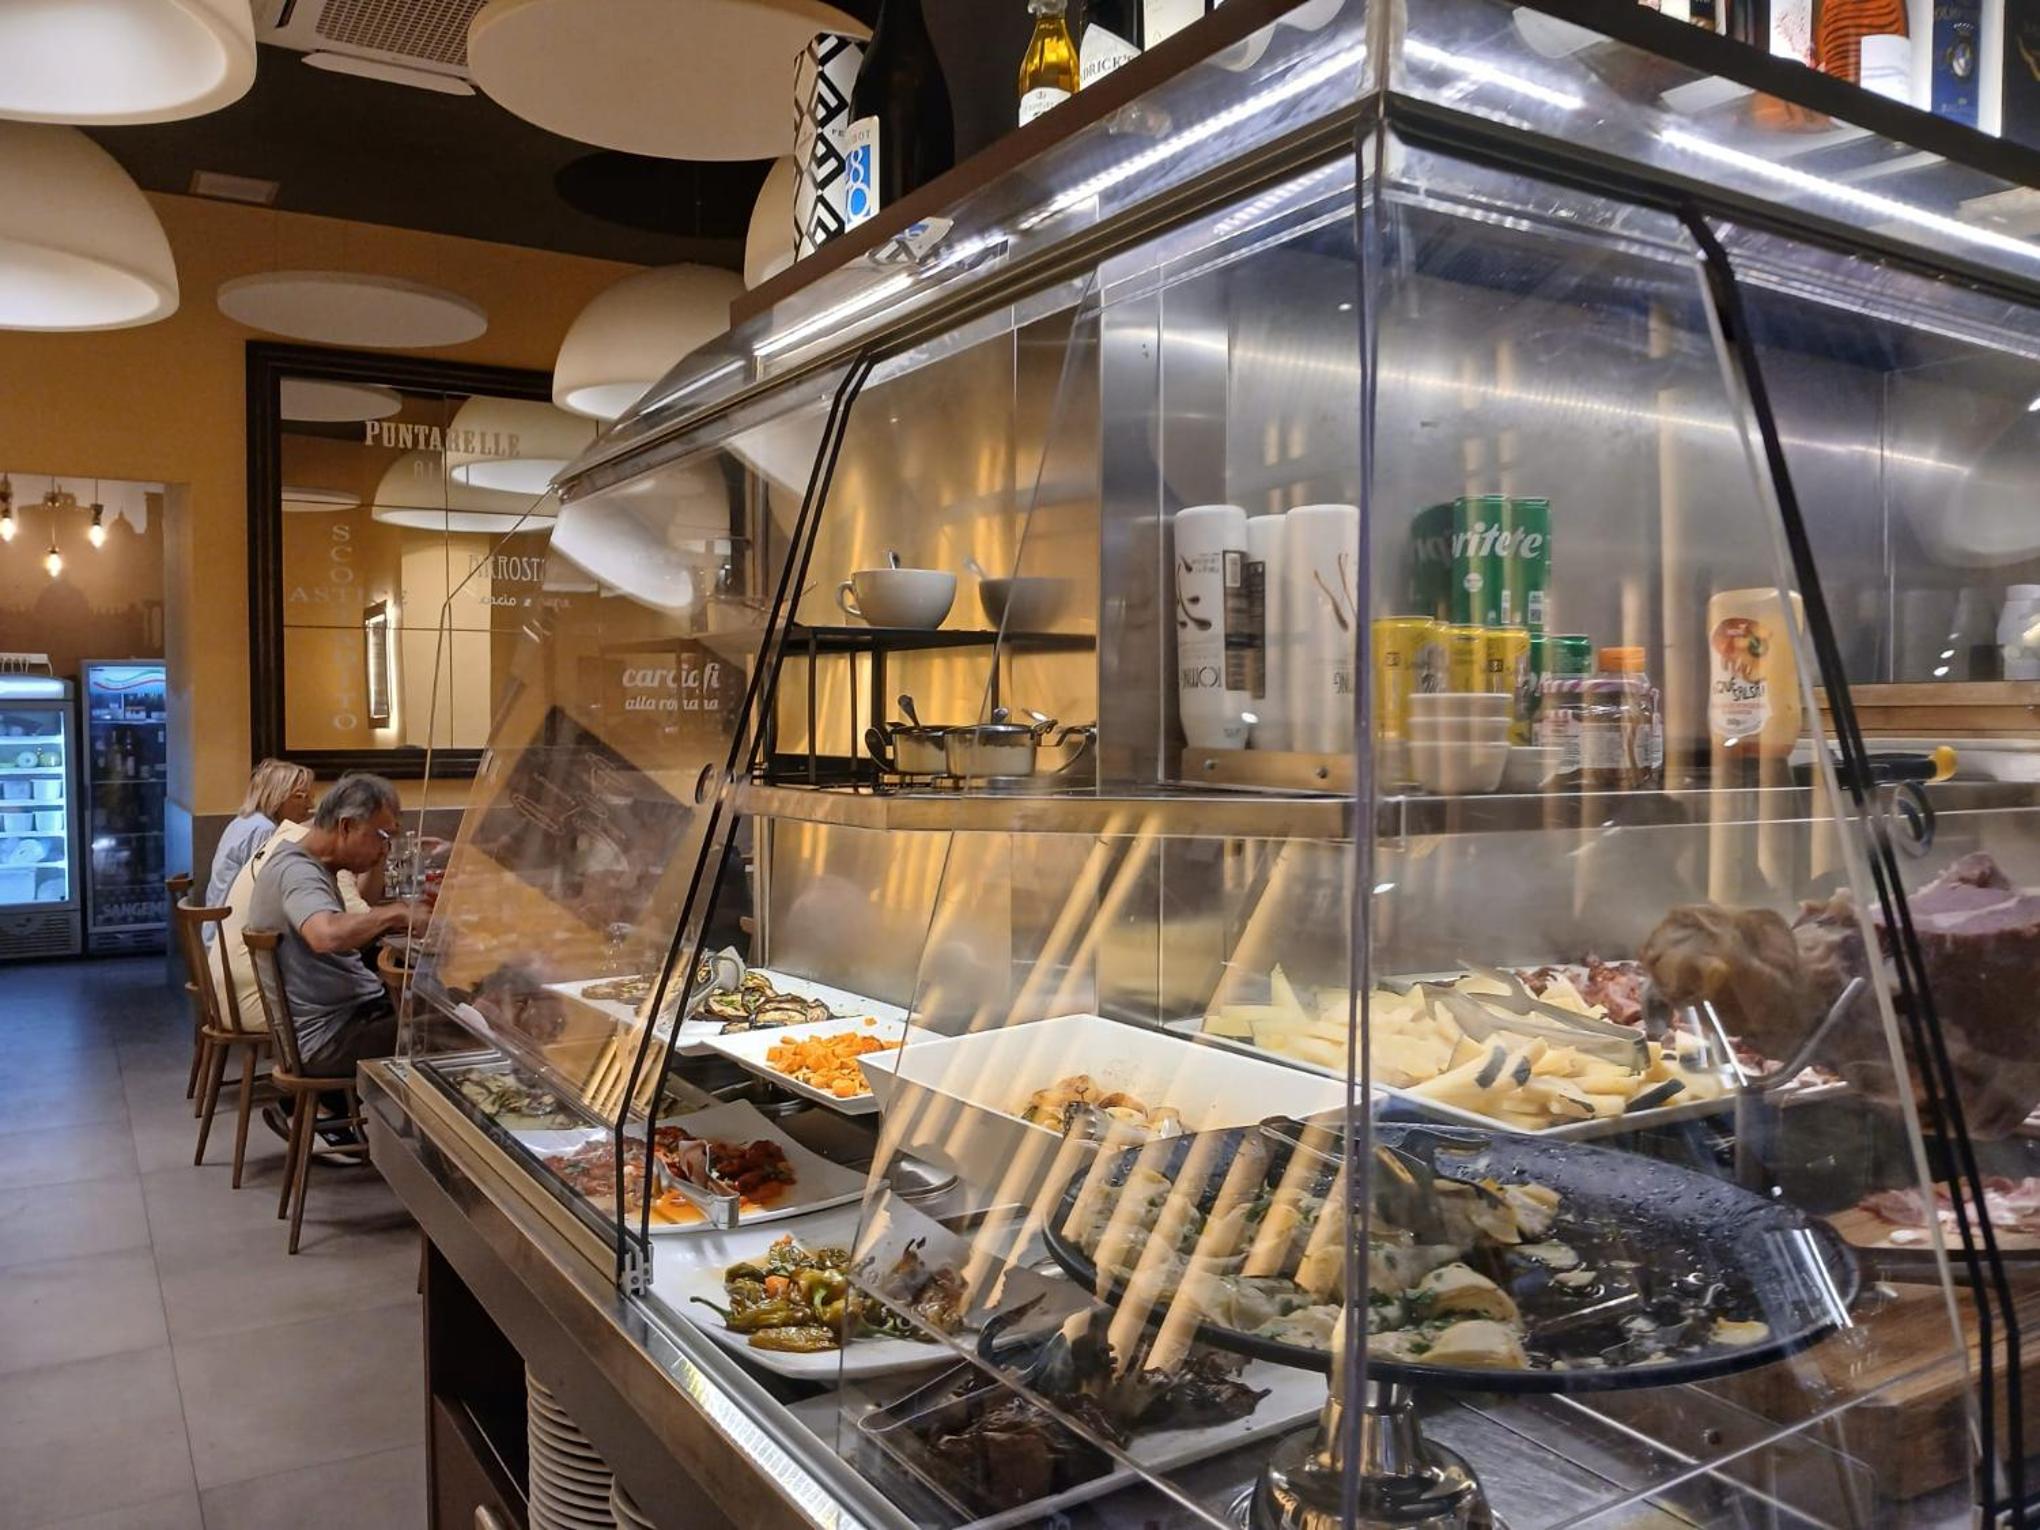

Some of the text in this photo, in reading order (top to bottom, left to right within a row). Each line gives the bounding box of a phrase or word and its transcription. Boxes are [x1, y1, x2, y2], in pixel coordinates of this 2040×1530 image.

[364, 419, 521, 457] PUNTARELLE
[622, 662, 721, 695] carciofi
[625, 696, 656, 710] alla
